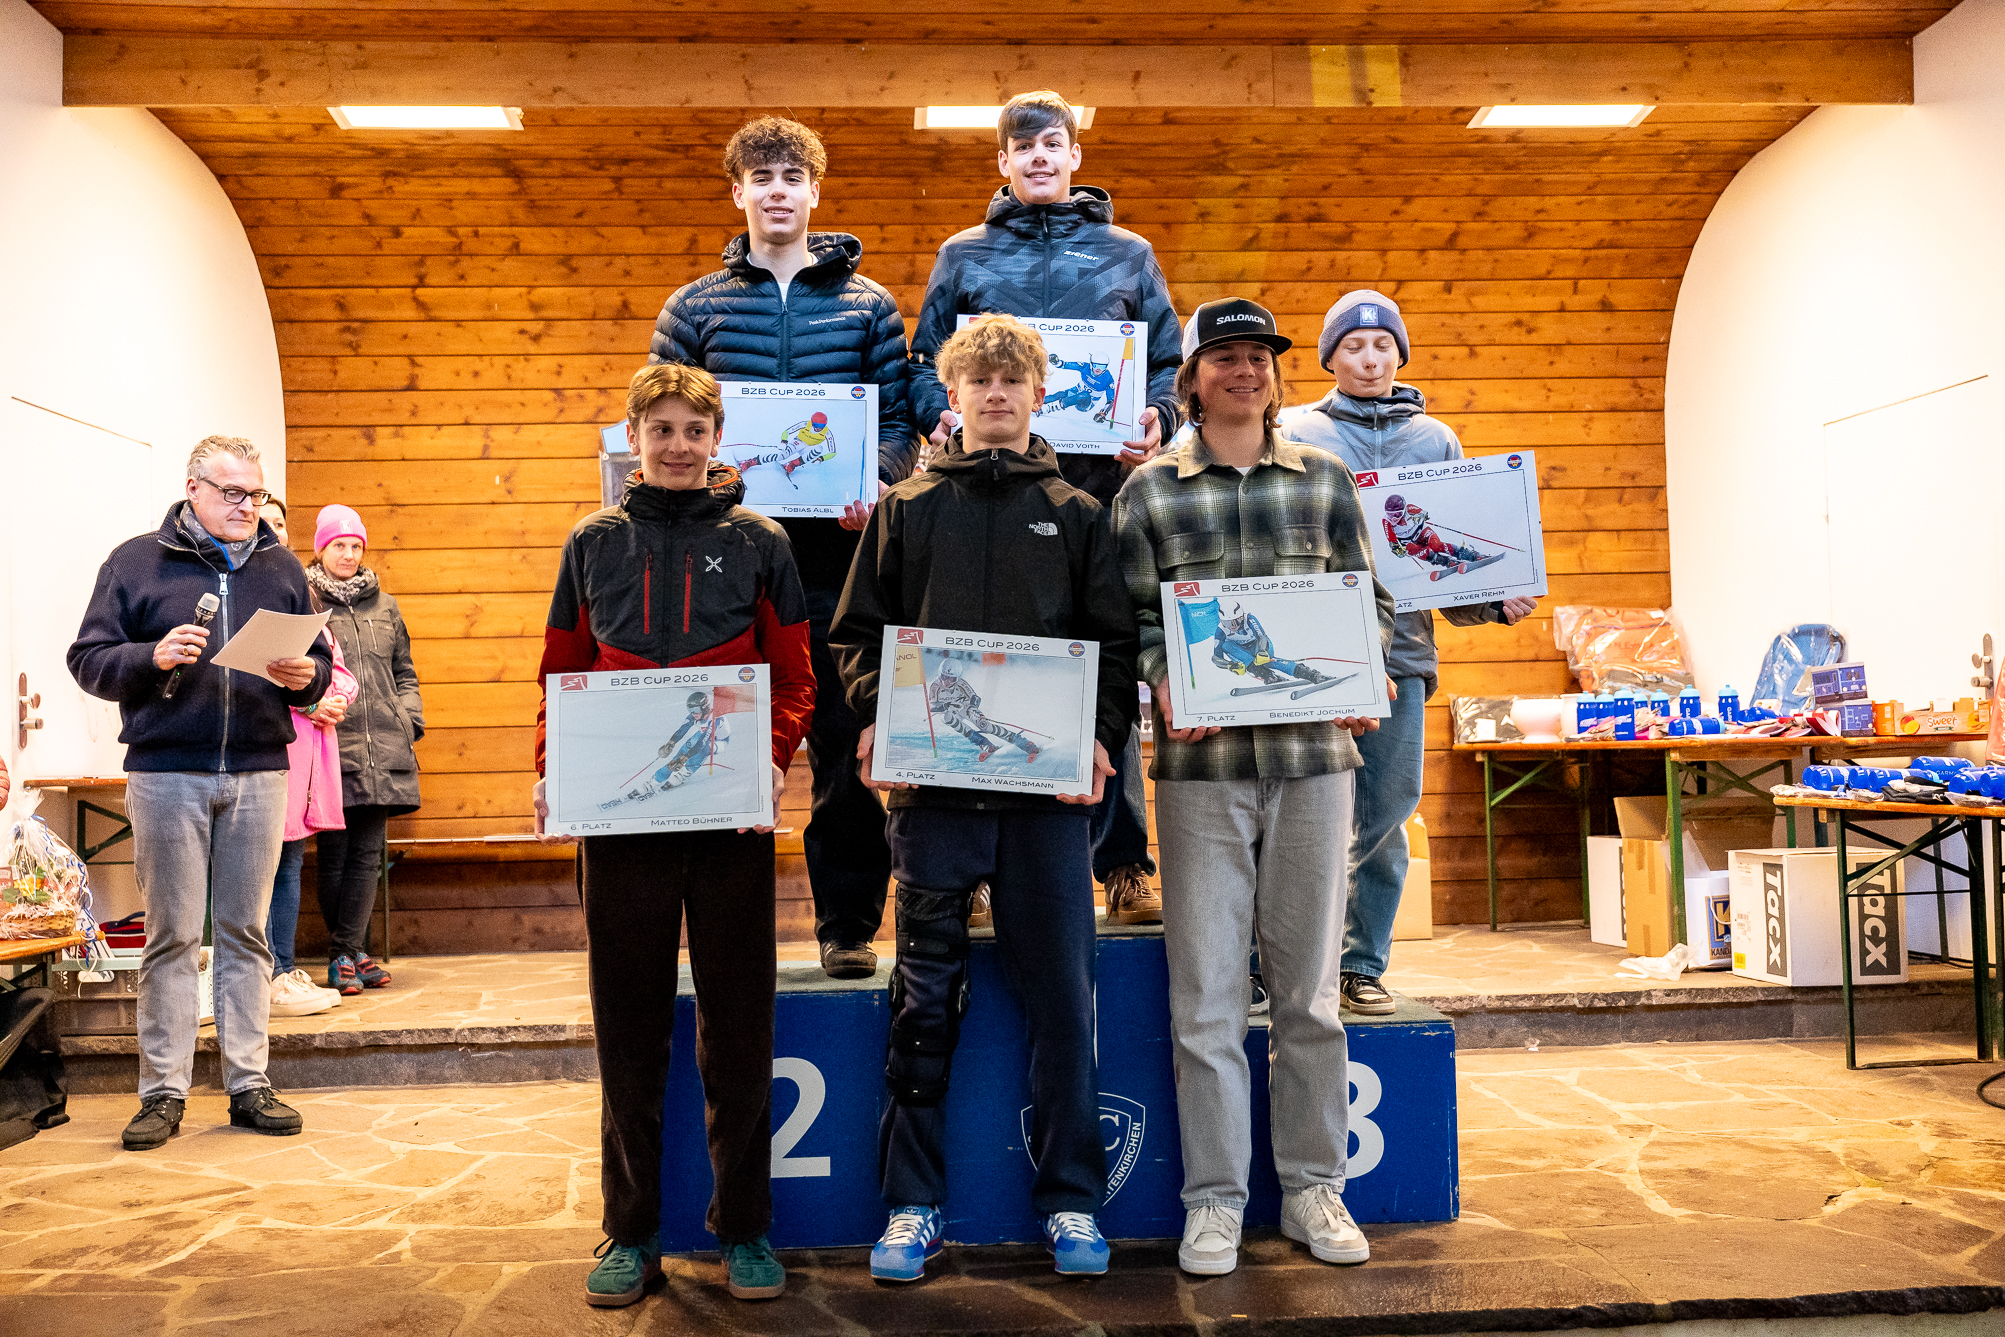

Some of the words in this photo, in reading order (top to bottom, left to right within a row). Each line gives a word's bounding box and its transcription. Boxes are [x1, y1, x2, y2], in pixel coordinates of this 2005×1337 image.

[1216, 313, 1266, 326] SALOMON
[1064, 324, 1095, 333] 2026
[741, 387, 767, 396] BZB
[795, 389, 826, 397] 2026
[1075, 442, 1101, 450] VOITH
[1397, 470, 1424, 481] BZB
[1452, 463, 1483, 475] 2026
[1221, 583, 1250, 593] BZB
[1281, 580, 1315, 590] 2026
[1453, 592, 1480, 601] XAVER
[1481, 590, 1505, 598] REHM
[944, 637, 974, 648] BZB
[1005, 641, 1040, 652] 2026
[610, 677, 640, 687] BZB
[674, 674, 709, 684] 2026
[1269, 710, 1314, 719] BENEDIKT
[1316, 708, 1356, 716] JOCHUM
[1926, 716, 1958, 728] Sweet
[906, 772, 936, 780] PLATZ
[971, 776, 993, 785] MAX
[994, 778, 1054, 789] WACHSMANN
[582, 822, 612, 830] PLATZ
[650, 818, 690, 827] MATTEO
[692, 816, 733, 825] BÜHNER
[1765, 870, 1782, 969] Tacx
[770, 1056, 831, 1178] 2
